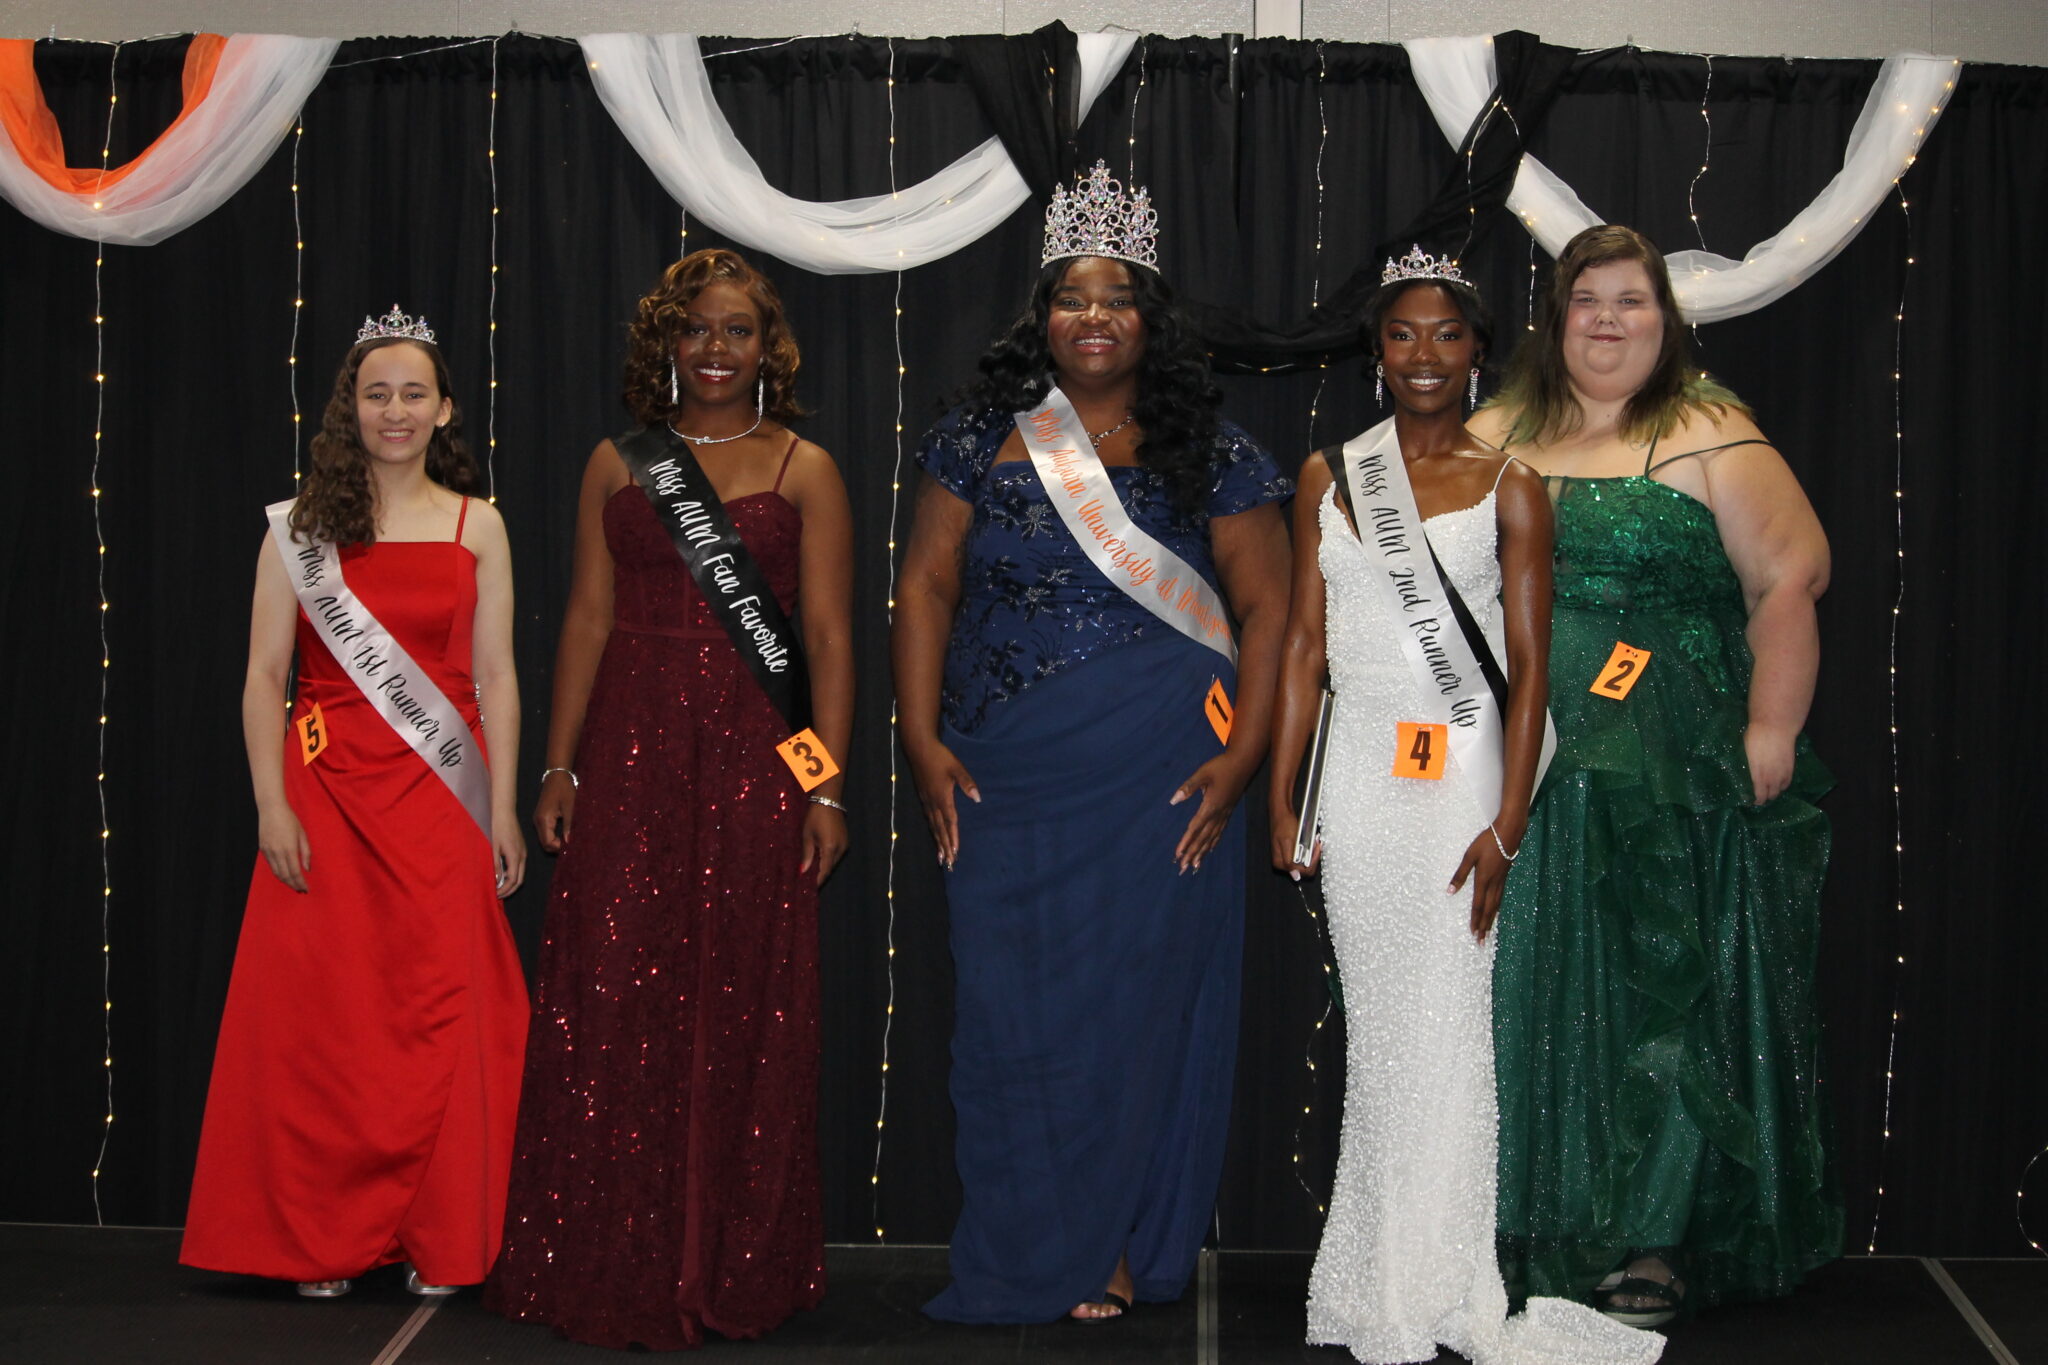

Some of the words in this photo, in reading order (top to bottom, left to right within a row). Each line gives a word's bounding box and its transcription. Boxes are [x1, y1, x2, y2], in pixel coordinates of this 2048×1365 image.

[1357, 454, 1389, 497] Miss
[1027, 408, 1066, 443] Miss
[1048, 449, 1085, 500] Auburn
[1077, 498, 1157, 587] University
[1155, 576, 1176, 602] at
[1370, 507, 1411, 558] AUM
[648, 458, 688, 496] Miss
[671, 501, 721, 550] AUM
[702, 553, 741, 594] Fan
[728, 595, 790, 674] Favorite
[1388, 567, 1432, 613] 2nd
[298, 545, 325, 588] Miss
[314, 596, 364, 644] AUM
[353, 646, 389, 677] 1st
[377, 674, 441, 742] Runner
[438, 737, 464, 769] Up
[1408, 617, 1463, 696] Runner
[1603, 660, 1636, 692] 2
[1211, 695, 1229, 725] 1
[1449, 698, 1483, 729] Up
[306, 719, 321, 755] 5
[1409, 730, 1432, 772] 4
[792, 741, 825, 778] 3
